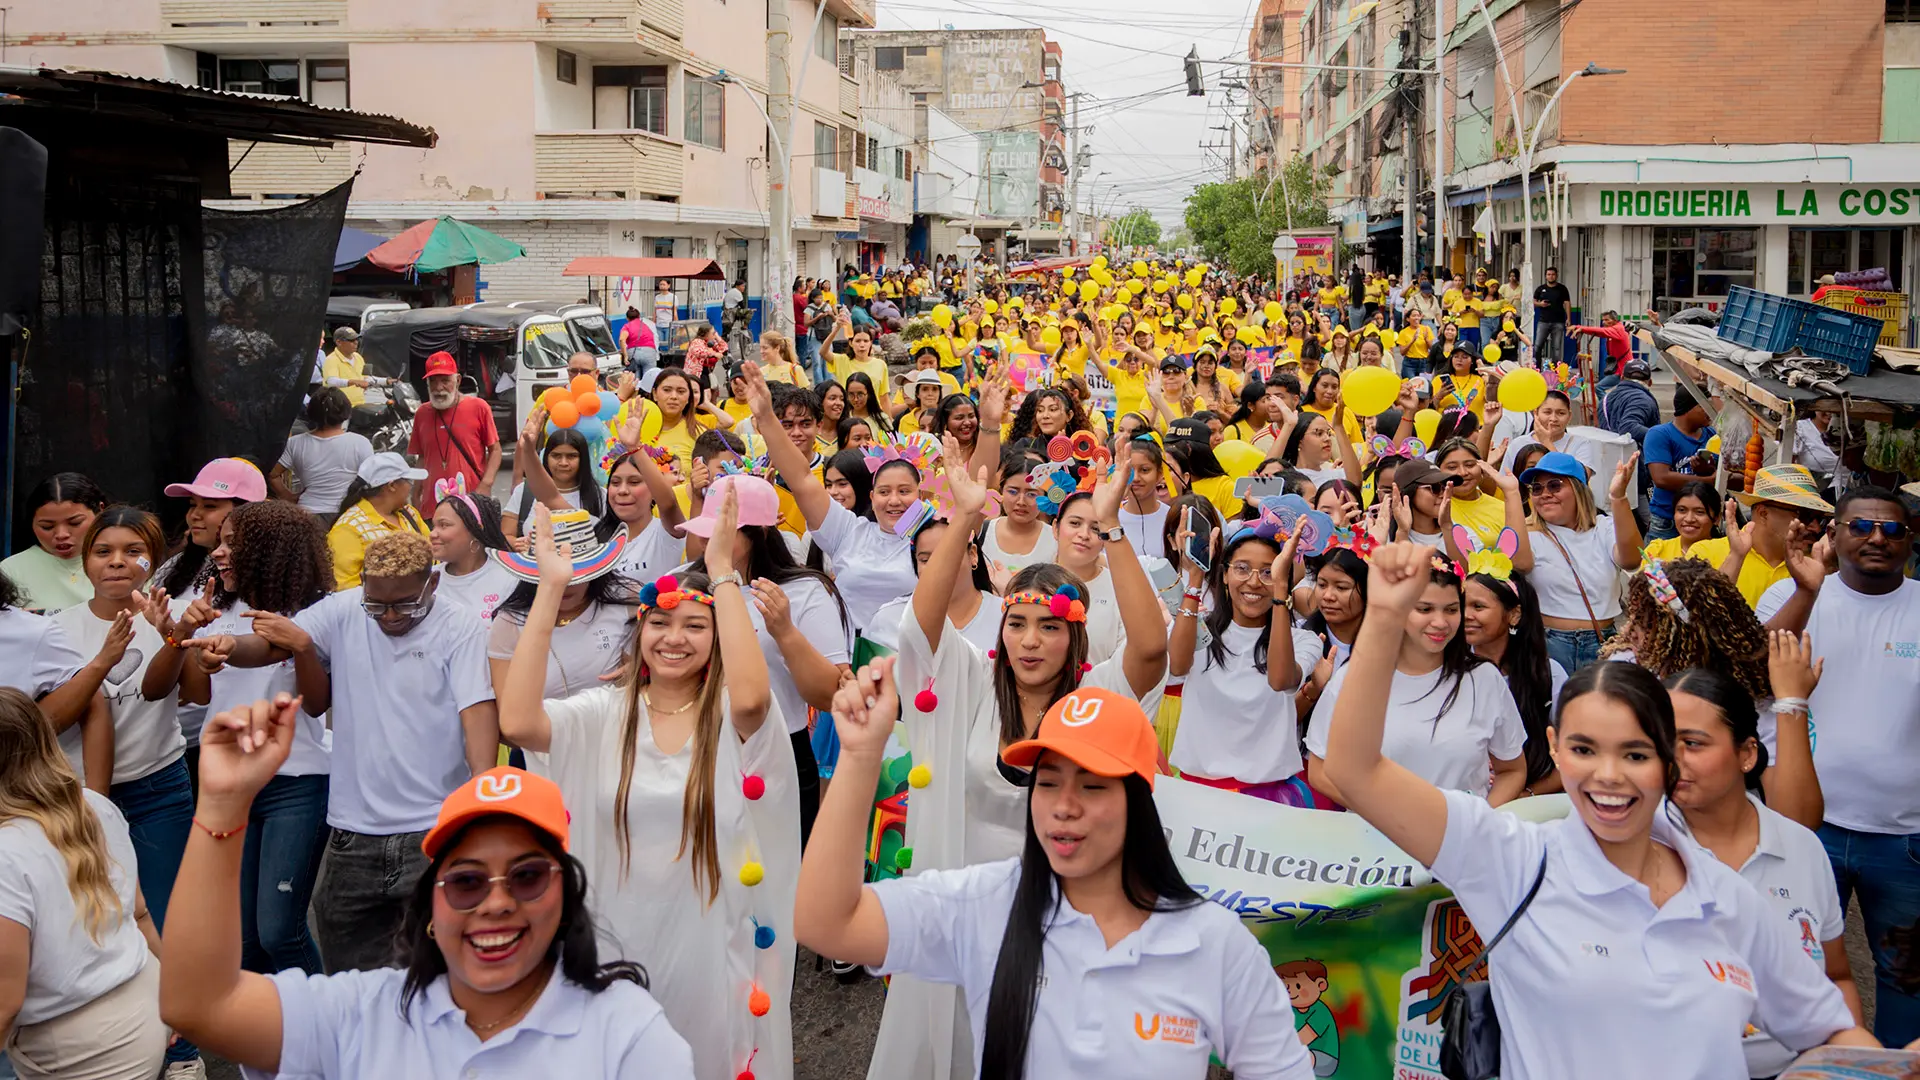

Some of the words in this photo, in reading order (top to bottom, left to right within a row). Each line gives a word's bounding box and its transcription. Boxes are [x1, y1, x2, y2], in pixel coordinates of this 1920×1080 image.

[956, 39, 1030, 54] COMPRA
[963, 58, 1024, 73] VENTA
[951, 93, 1036, 109] DIAMANTE
[997, 133, 1025, 147] LA
[857, 198, 889, 217] DROGAS
[1530, 194, 1573, 222] COTA
[1600, 190, 1751, 217] DROGUERIA
[1776, 189, 1819, 216] LA
[1184, 826, 1414, 887] Educación
[1595, 944, 1609, 956] 01
[1400, 1045, 1422, 1063] DE
